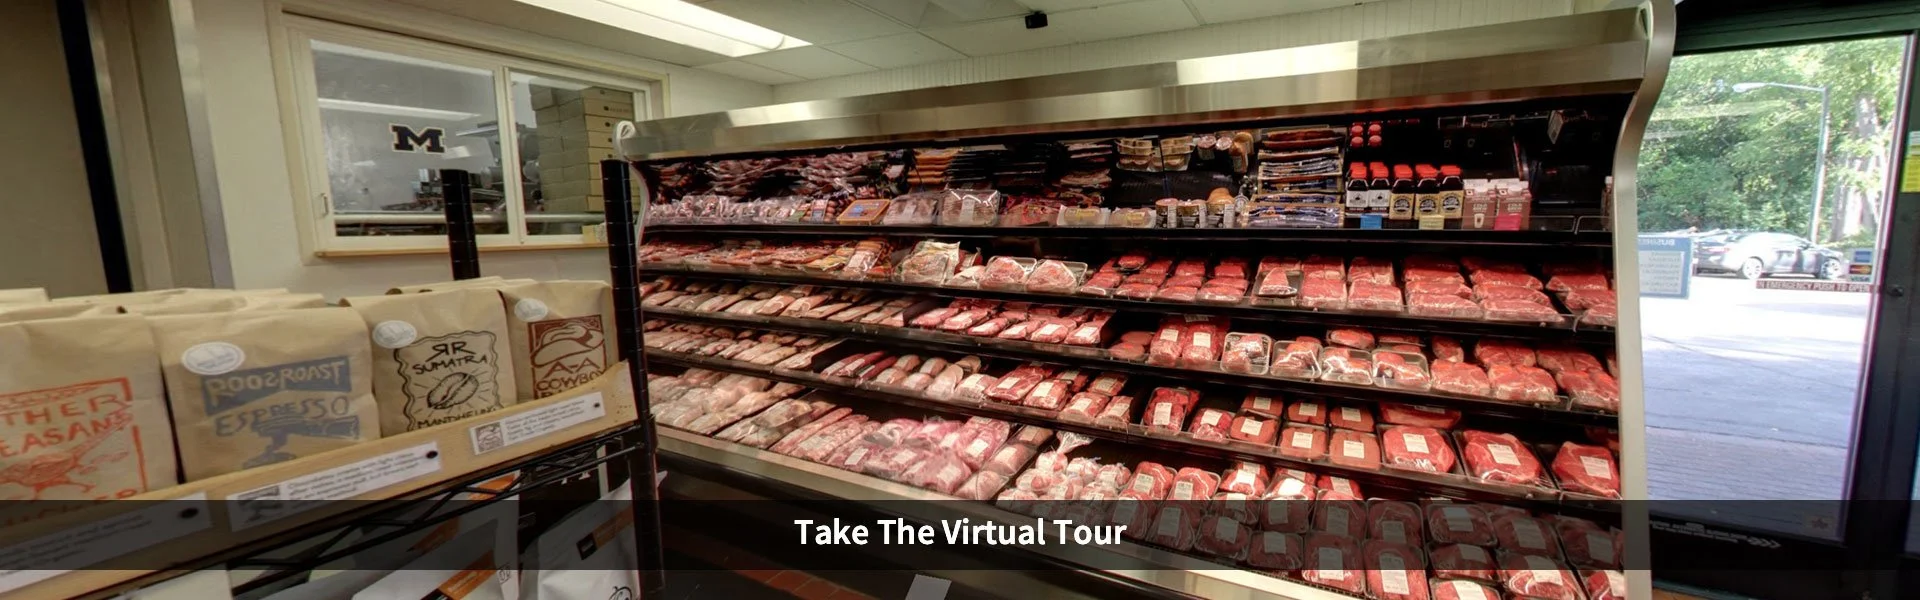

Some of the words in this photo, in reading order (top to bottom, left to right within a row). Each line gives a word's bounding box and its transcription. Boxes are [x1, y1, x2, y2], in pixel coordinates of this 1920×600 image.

[389, 123, 447, 154] M
[1766, 280, 1812, 290] EMERGENCY
[1813, 282, 1835, 291] PUSH
[412, 355, 488, 375] SUMATRA
[214, 395, 350, 437] ESPRESSO
